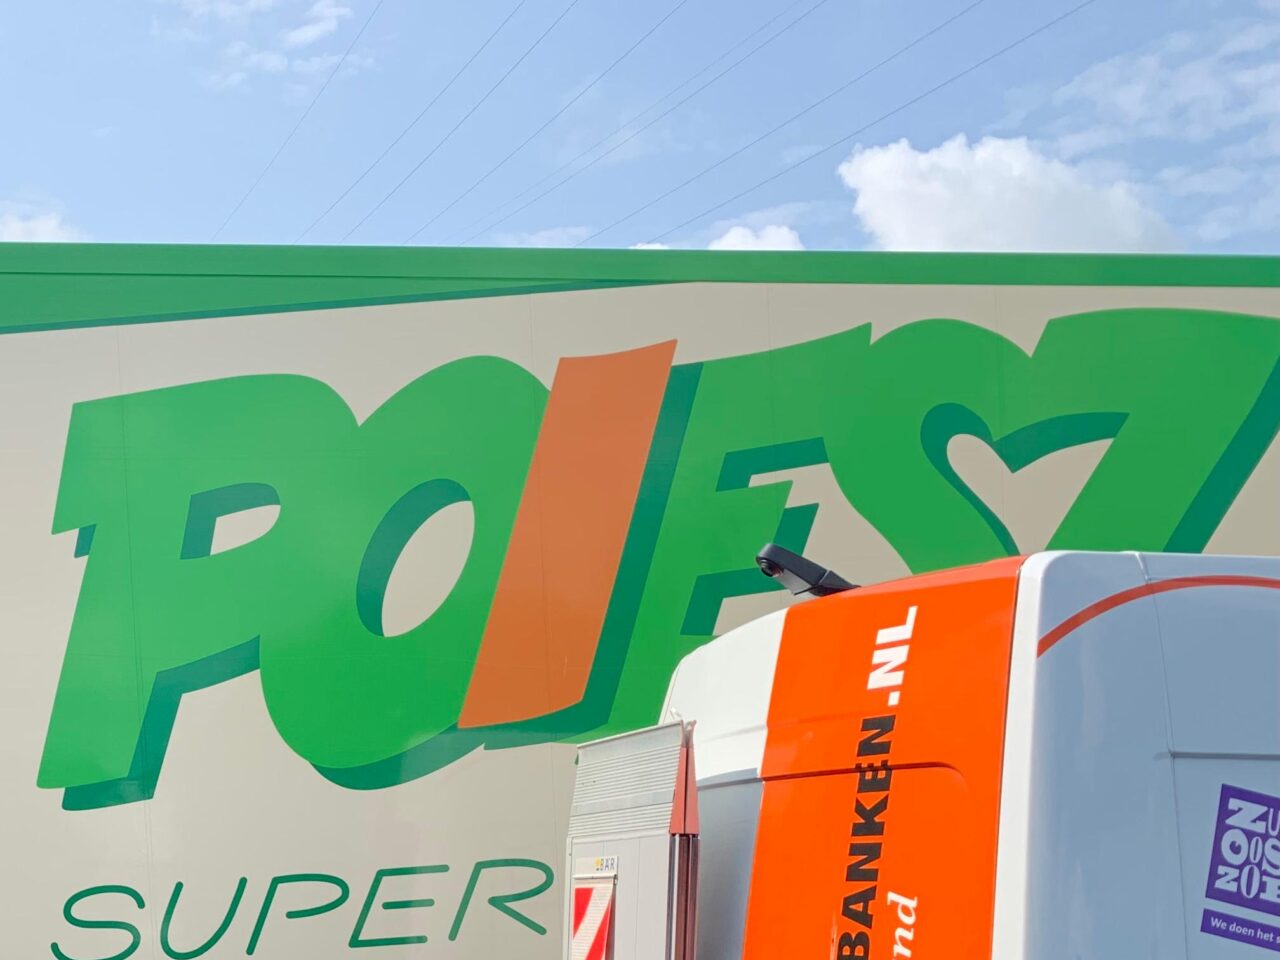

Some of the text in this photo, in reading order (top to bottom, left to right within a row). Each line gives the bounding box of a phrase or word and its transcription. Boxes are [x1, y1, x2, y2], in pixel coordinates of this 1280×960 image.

[1224, 797, 1280, 837] ZU
[1210, 916, 1228, 930] We
[1228, 921, 1255, 937] doen
[1256, 928, 1275, 942] het
